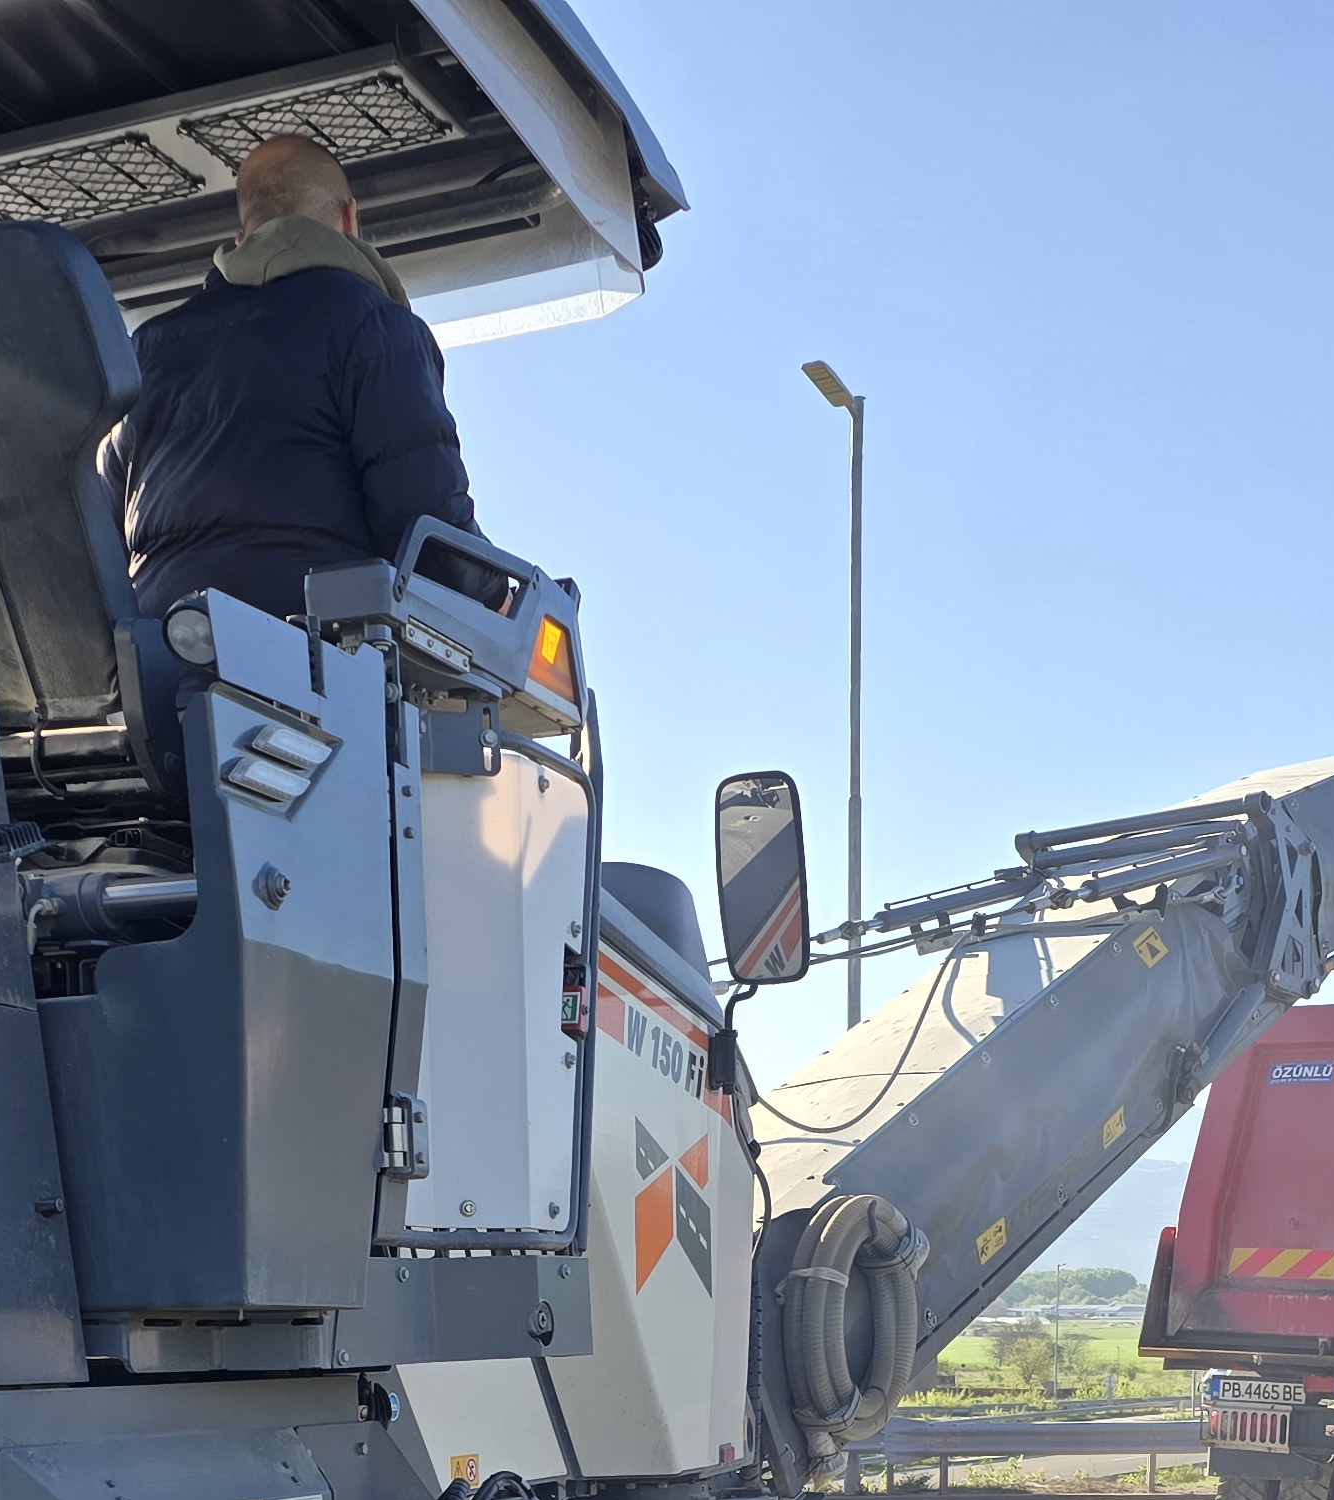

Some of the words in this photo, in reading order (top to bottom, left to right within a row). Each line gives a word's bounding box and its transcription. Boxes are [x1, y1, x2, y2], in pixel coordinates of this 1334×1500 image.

[627, 1004, 648, 1058] W
[651, 1025, 684, 1085] 150
[685, 1050, 705, 1101] Fi
[1272, 1064, 1334, 1079] ÖZÜNLÜ
